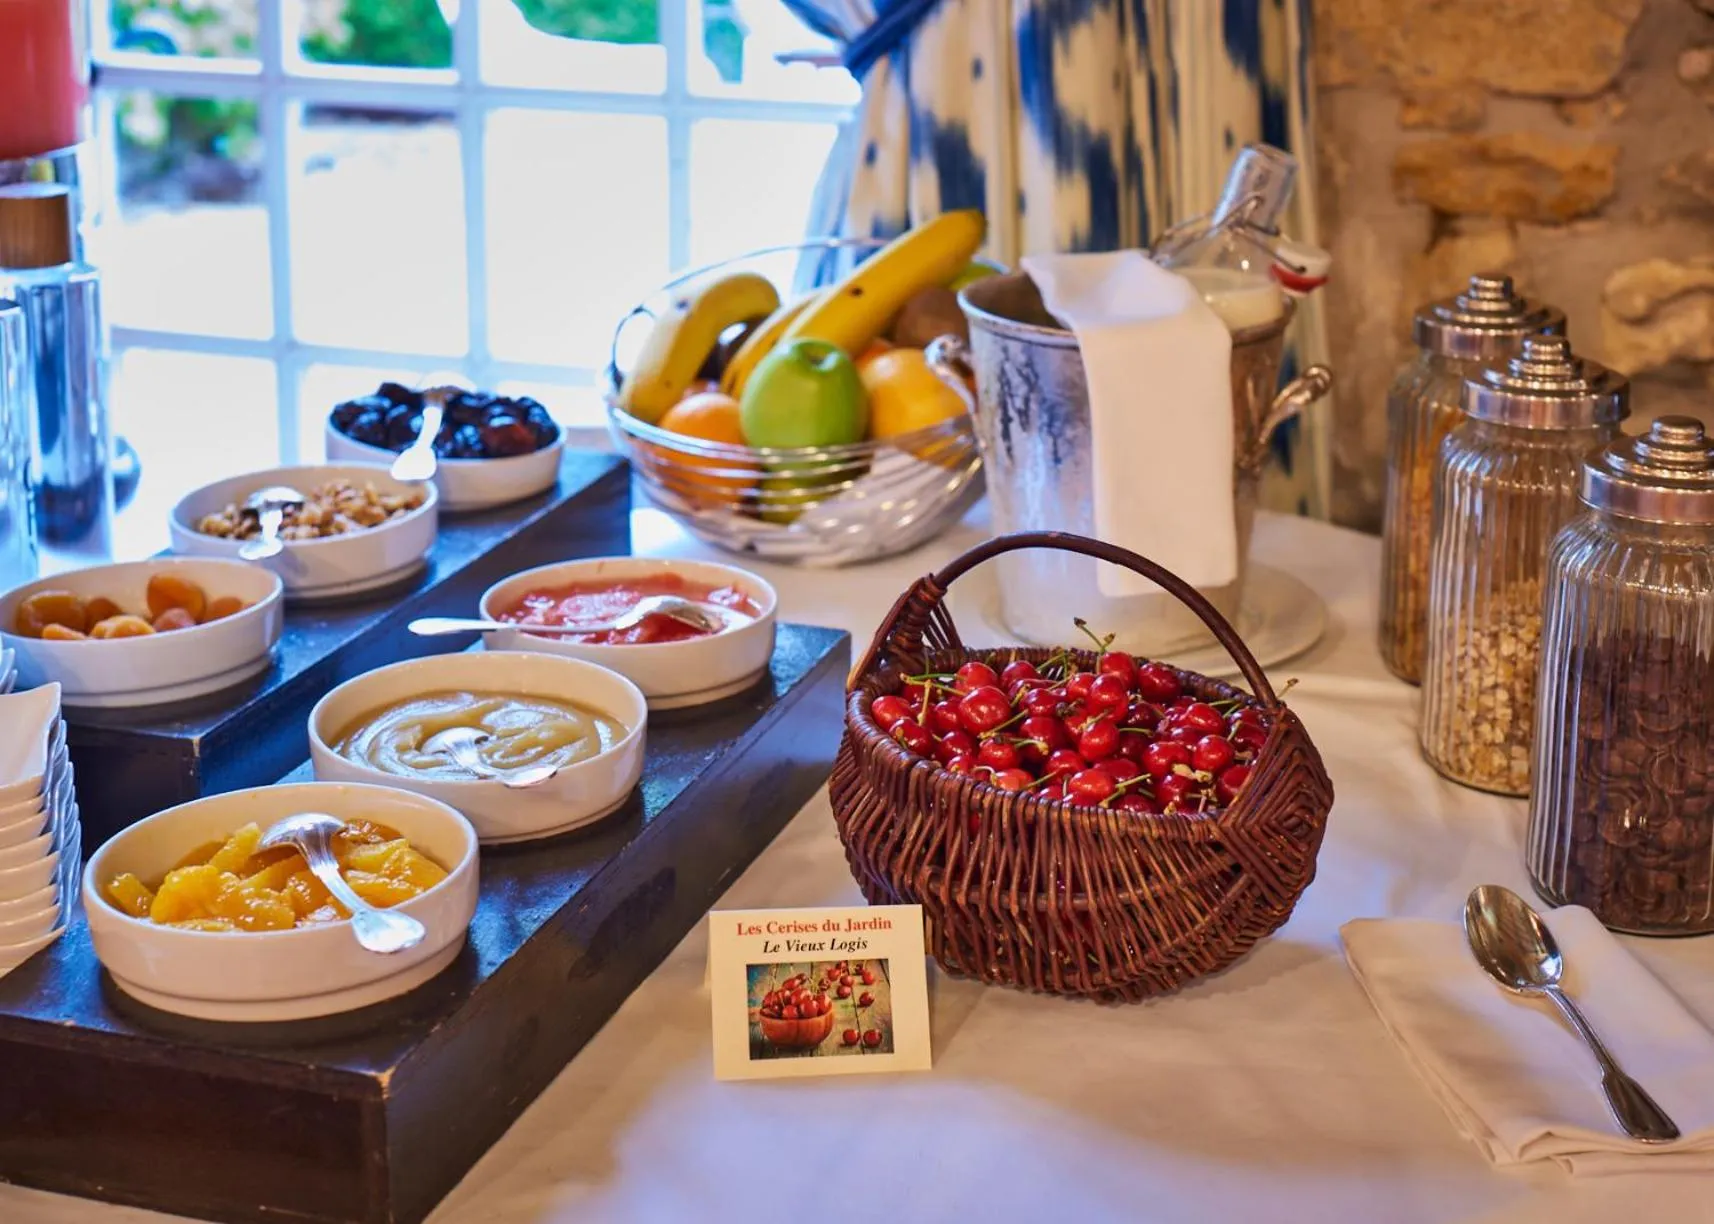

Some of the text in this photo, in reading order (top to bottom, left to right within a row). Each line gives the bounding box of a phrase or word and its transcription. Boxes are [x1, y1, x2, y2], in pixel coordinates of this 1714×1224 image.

[736, 917, 892, 936] Les Cerises du Jardin
[763, 937, 868, 954] Le Vieux Logis
